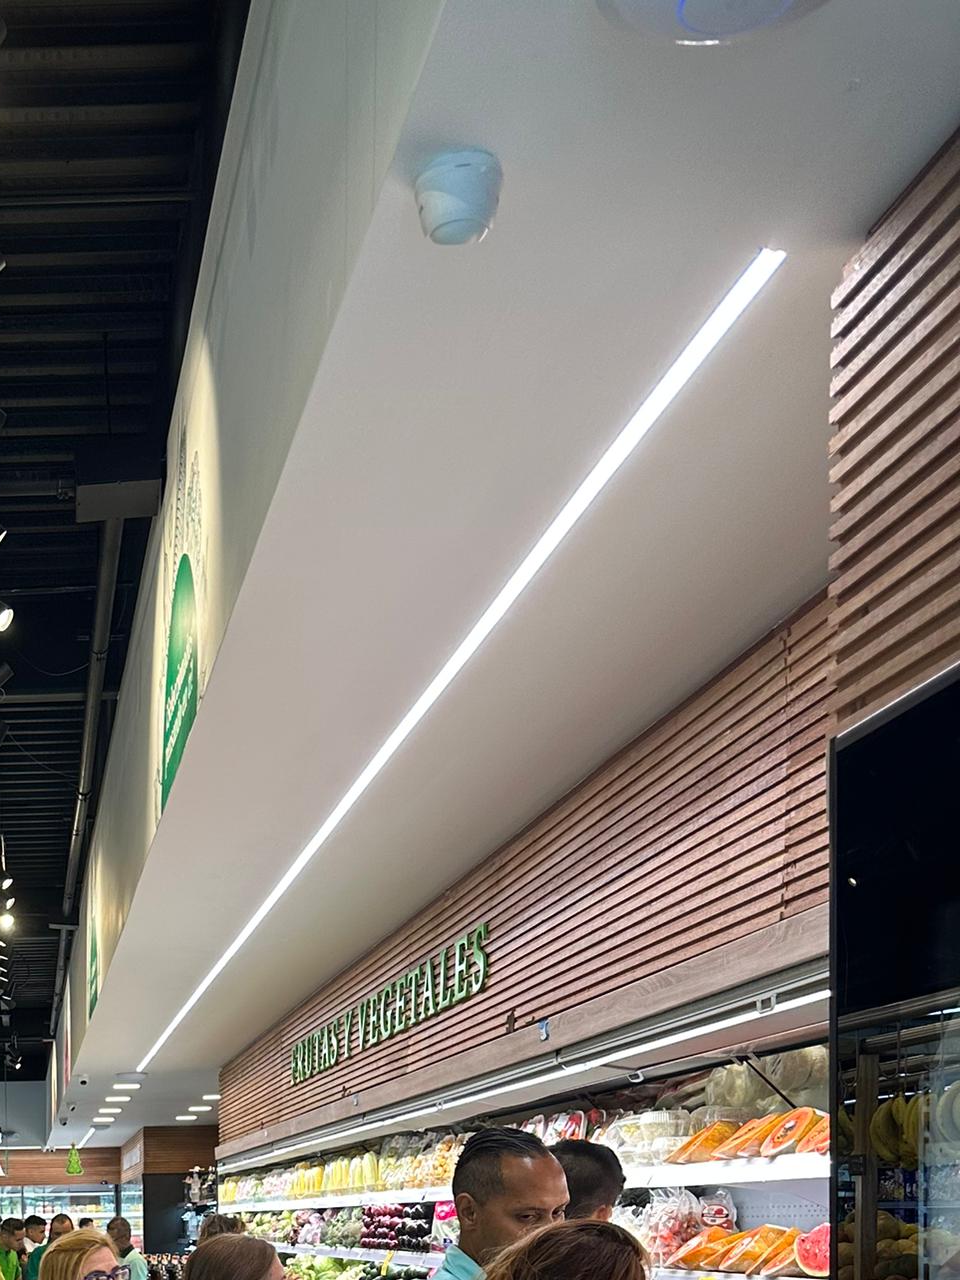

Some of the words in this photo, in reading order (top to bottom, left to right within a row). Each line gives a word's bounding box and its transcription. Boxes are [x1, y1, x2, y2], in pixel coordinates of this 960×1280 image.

[290, 1018, 340, 1086] FRUTAS
[343, 1010, 354, 1059] Y
[358, 922, 490, 1051] VEGETALES
